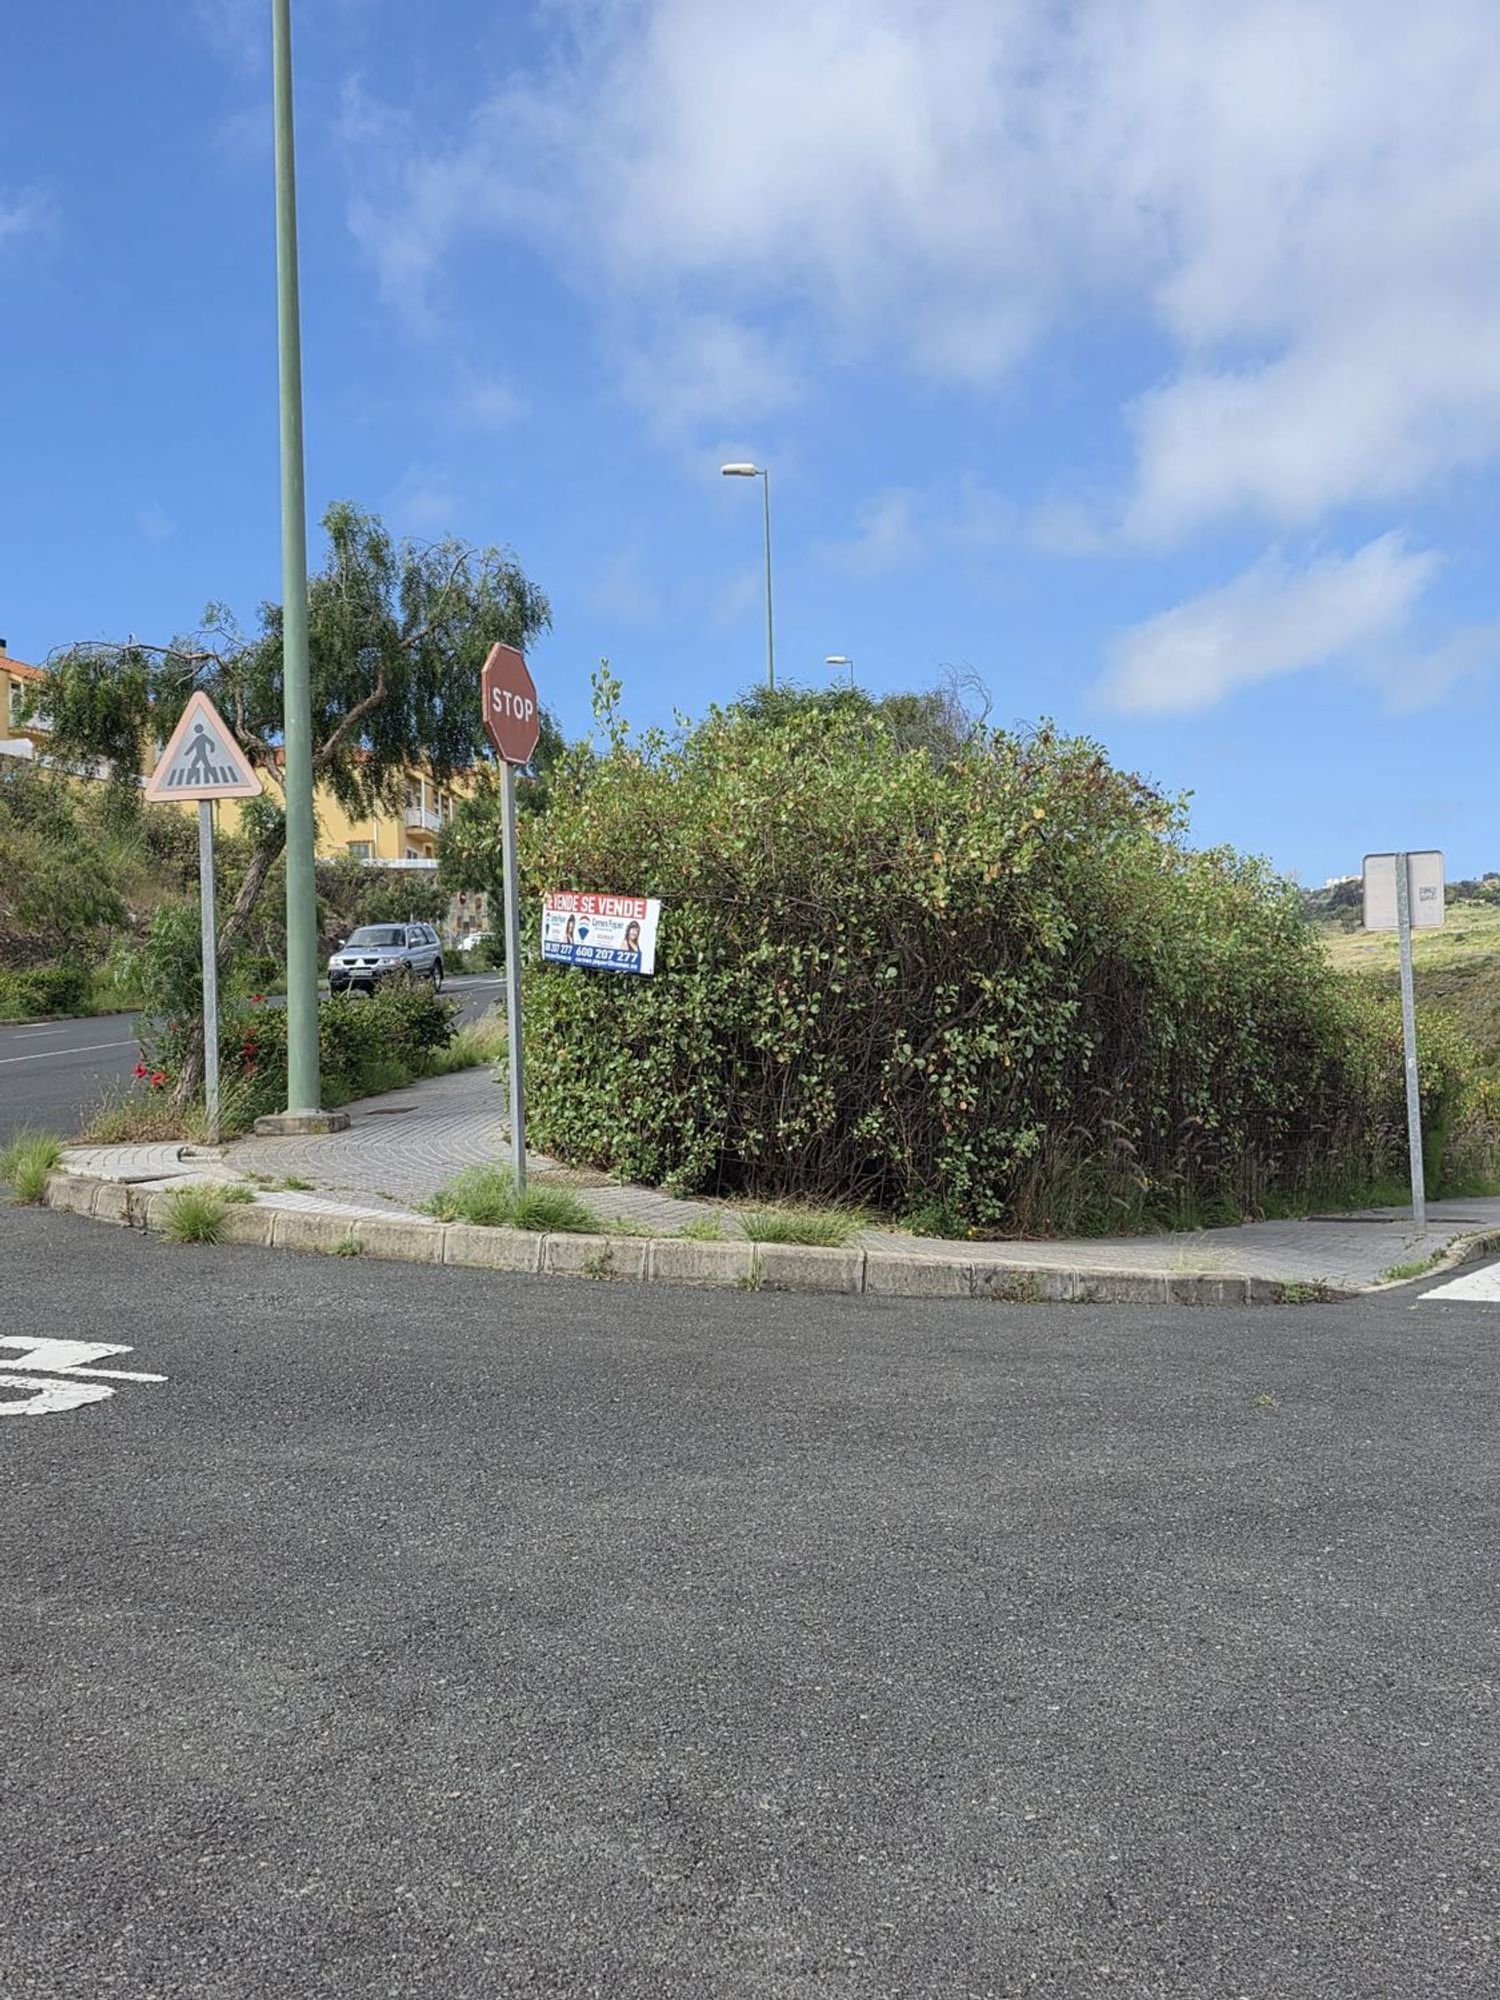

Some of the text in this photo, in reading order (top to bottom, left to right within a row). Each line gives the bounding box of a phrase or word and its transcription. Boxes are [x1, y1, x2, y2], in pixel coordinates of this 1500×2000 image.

[493, 687, 533, 722] STOP
[554, 893, 579, 911] VENDE
[581, 896, 596, 913] SE
[598, 897, 645, 918] VENDE
[576, 946, 593, 957] 600
[595, 949, 614, 960] 207
[617, 951, 638, 963] 277
